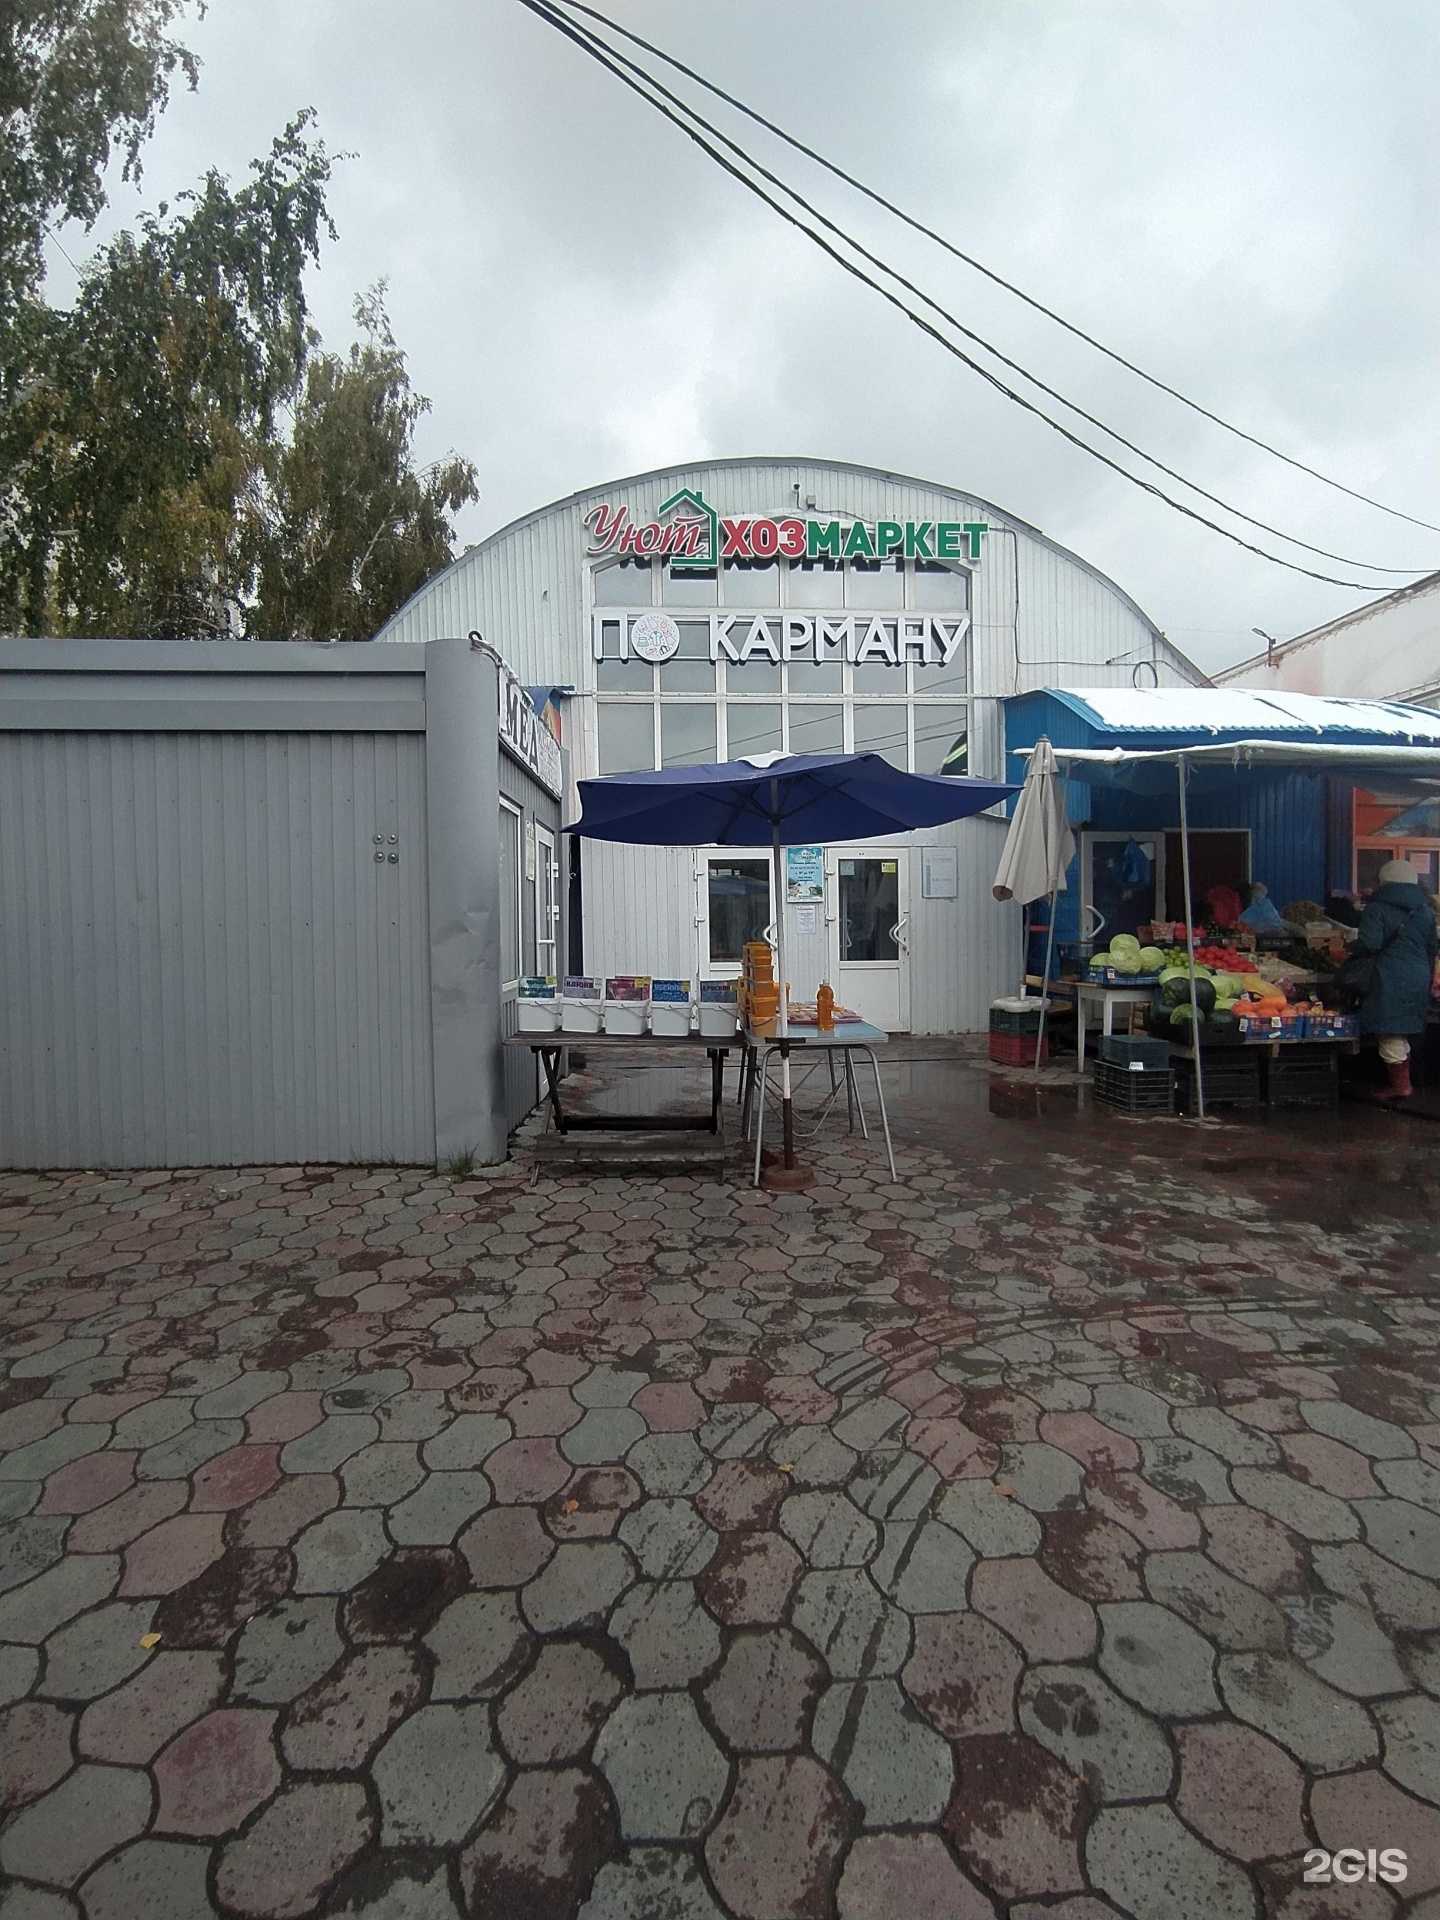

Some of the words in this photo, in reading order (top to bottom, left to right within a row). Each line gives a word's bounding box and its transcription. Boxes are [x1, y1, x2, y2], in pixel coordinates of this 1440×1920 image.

[584, 503, 709, 557] Уют
[721, 518, 989, 560] ХОЗМАРКЕТ
[593, 613, 680, 663] ПО
[709, 614, 971, 664] КАРМАНУ
